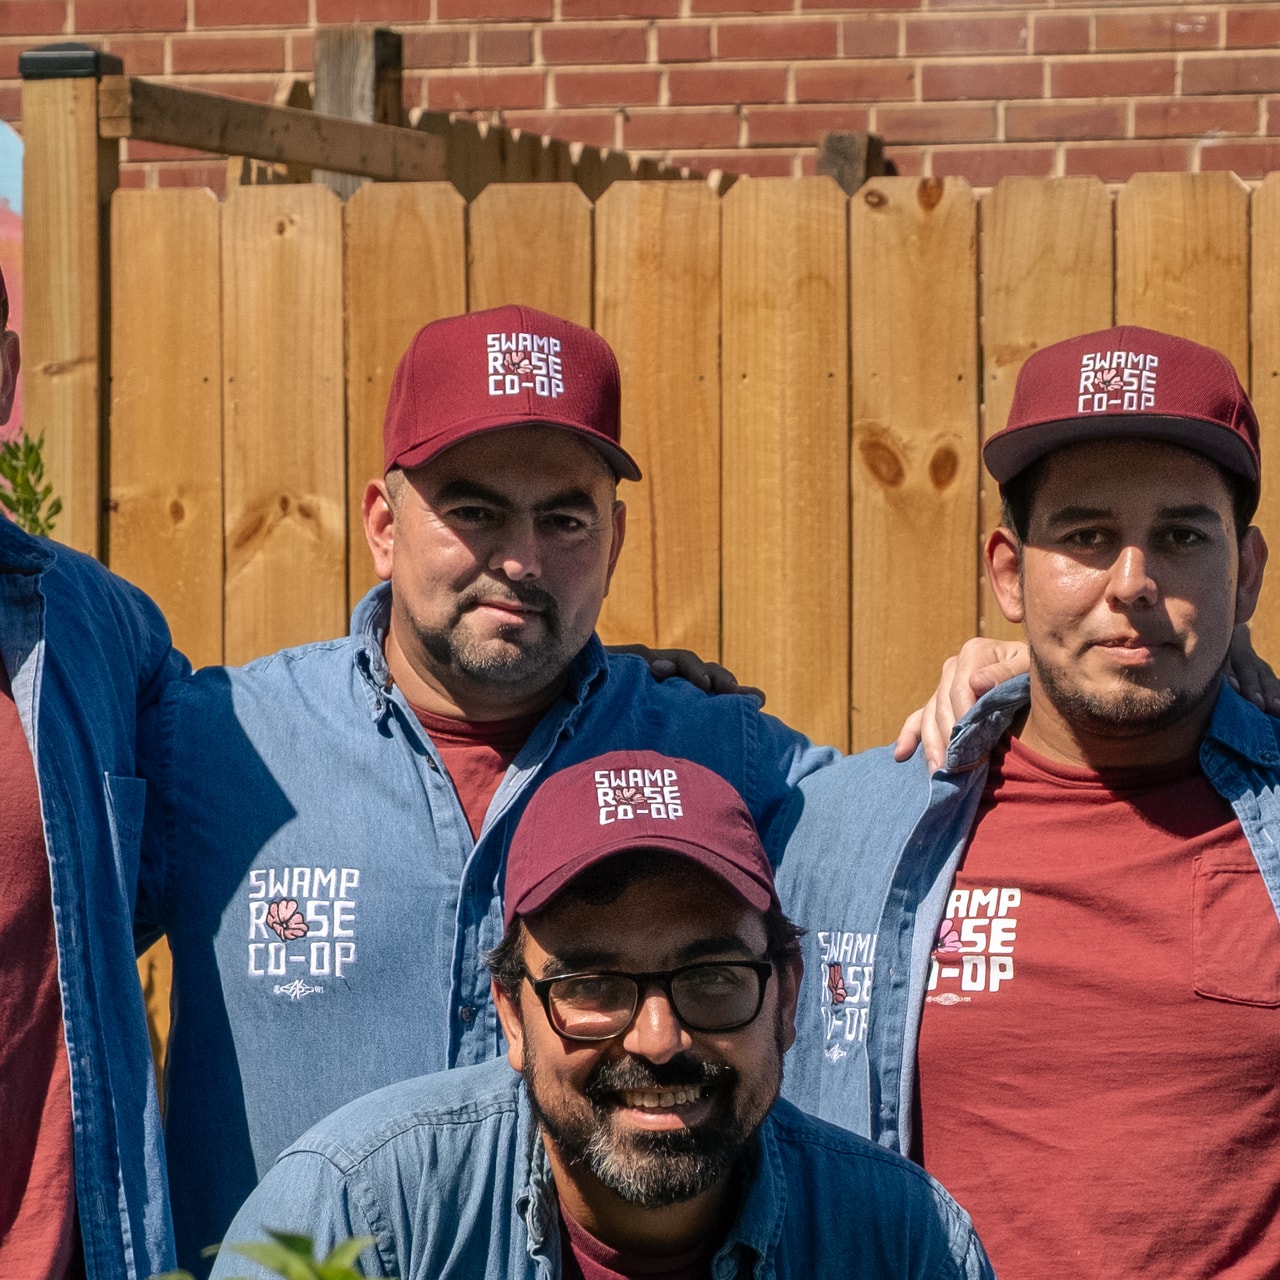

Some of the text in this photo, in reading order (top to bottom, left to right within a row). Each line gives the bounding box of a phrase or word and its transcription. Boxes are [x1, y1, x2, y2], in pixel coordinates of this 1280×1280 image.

[487, 333, 562, 353] SWAMP
[488, 351, 563, 379] RSE
[1080, 351, 1159, 372] SWAMP
[488, 375, 565, 398] CO-OP
[1079, 368, 1158, 394] RSE
[1077, 392, 1157, 413] CO-OP
[594, 768, 678, 788] SWAMP
[596, 786, 681, 807] RSE
[599, 803, 684, 825] CO-OP
[248, 867, 360, 899] SWAMP
[946, 887, 1021, 918] AMP
[248, 899, 356, 941] RSE
[247, 941, 356, 978] CO-OP
[821, 963, 873, 1005] RSE
